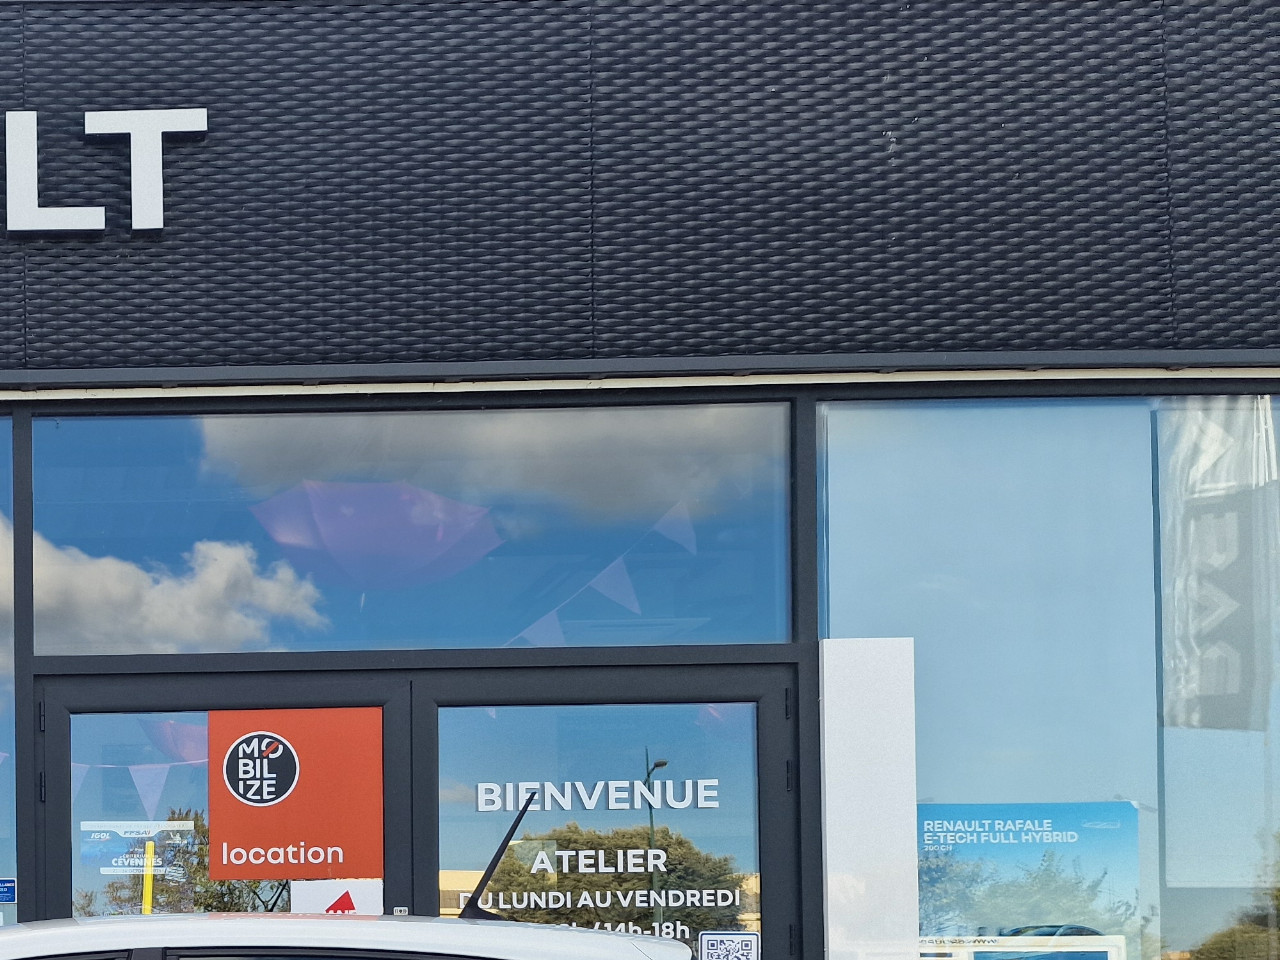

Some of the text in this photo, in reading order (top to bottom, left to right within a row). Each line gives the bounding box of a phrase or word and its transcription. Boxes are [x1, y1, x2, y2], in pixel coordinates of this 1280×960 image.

[238, 759, 277, 779] BIL
[238, 780, 277, 799] IZE
[476, 778, 720, 812] BIENVENUE
[924, 819, 1052, 832] RENAULT RAFALE
[924, 831, 1079, 844] E-TECH FULL HYBRID
[222, 841, 343, 865] location
[530, 849, 667, 874] ATELIER
[458, 888, 740, 909] DU LUNDI AU VENDREDI
